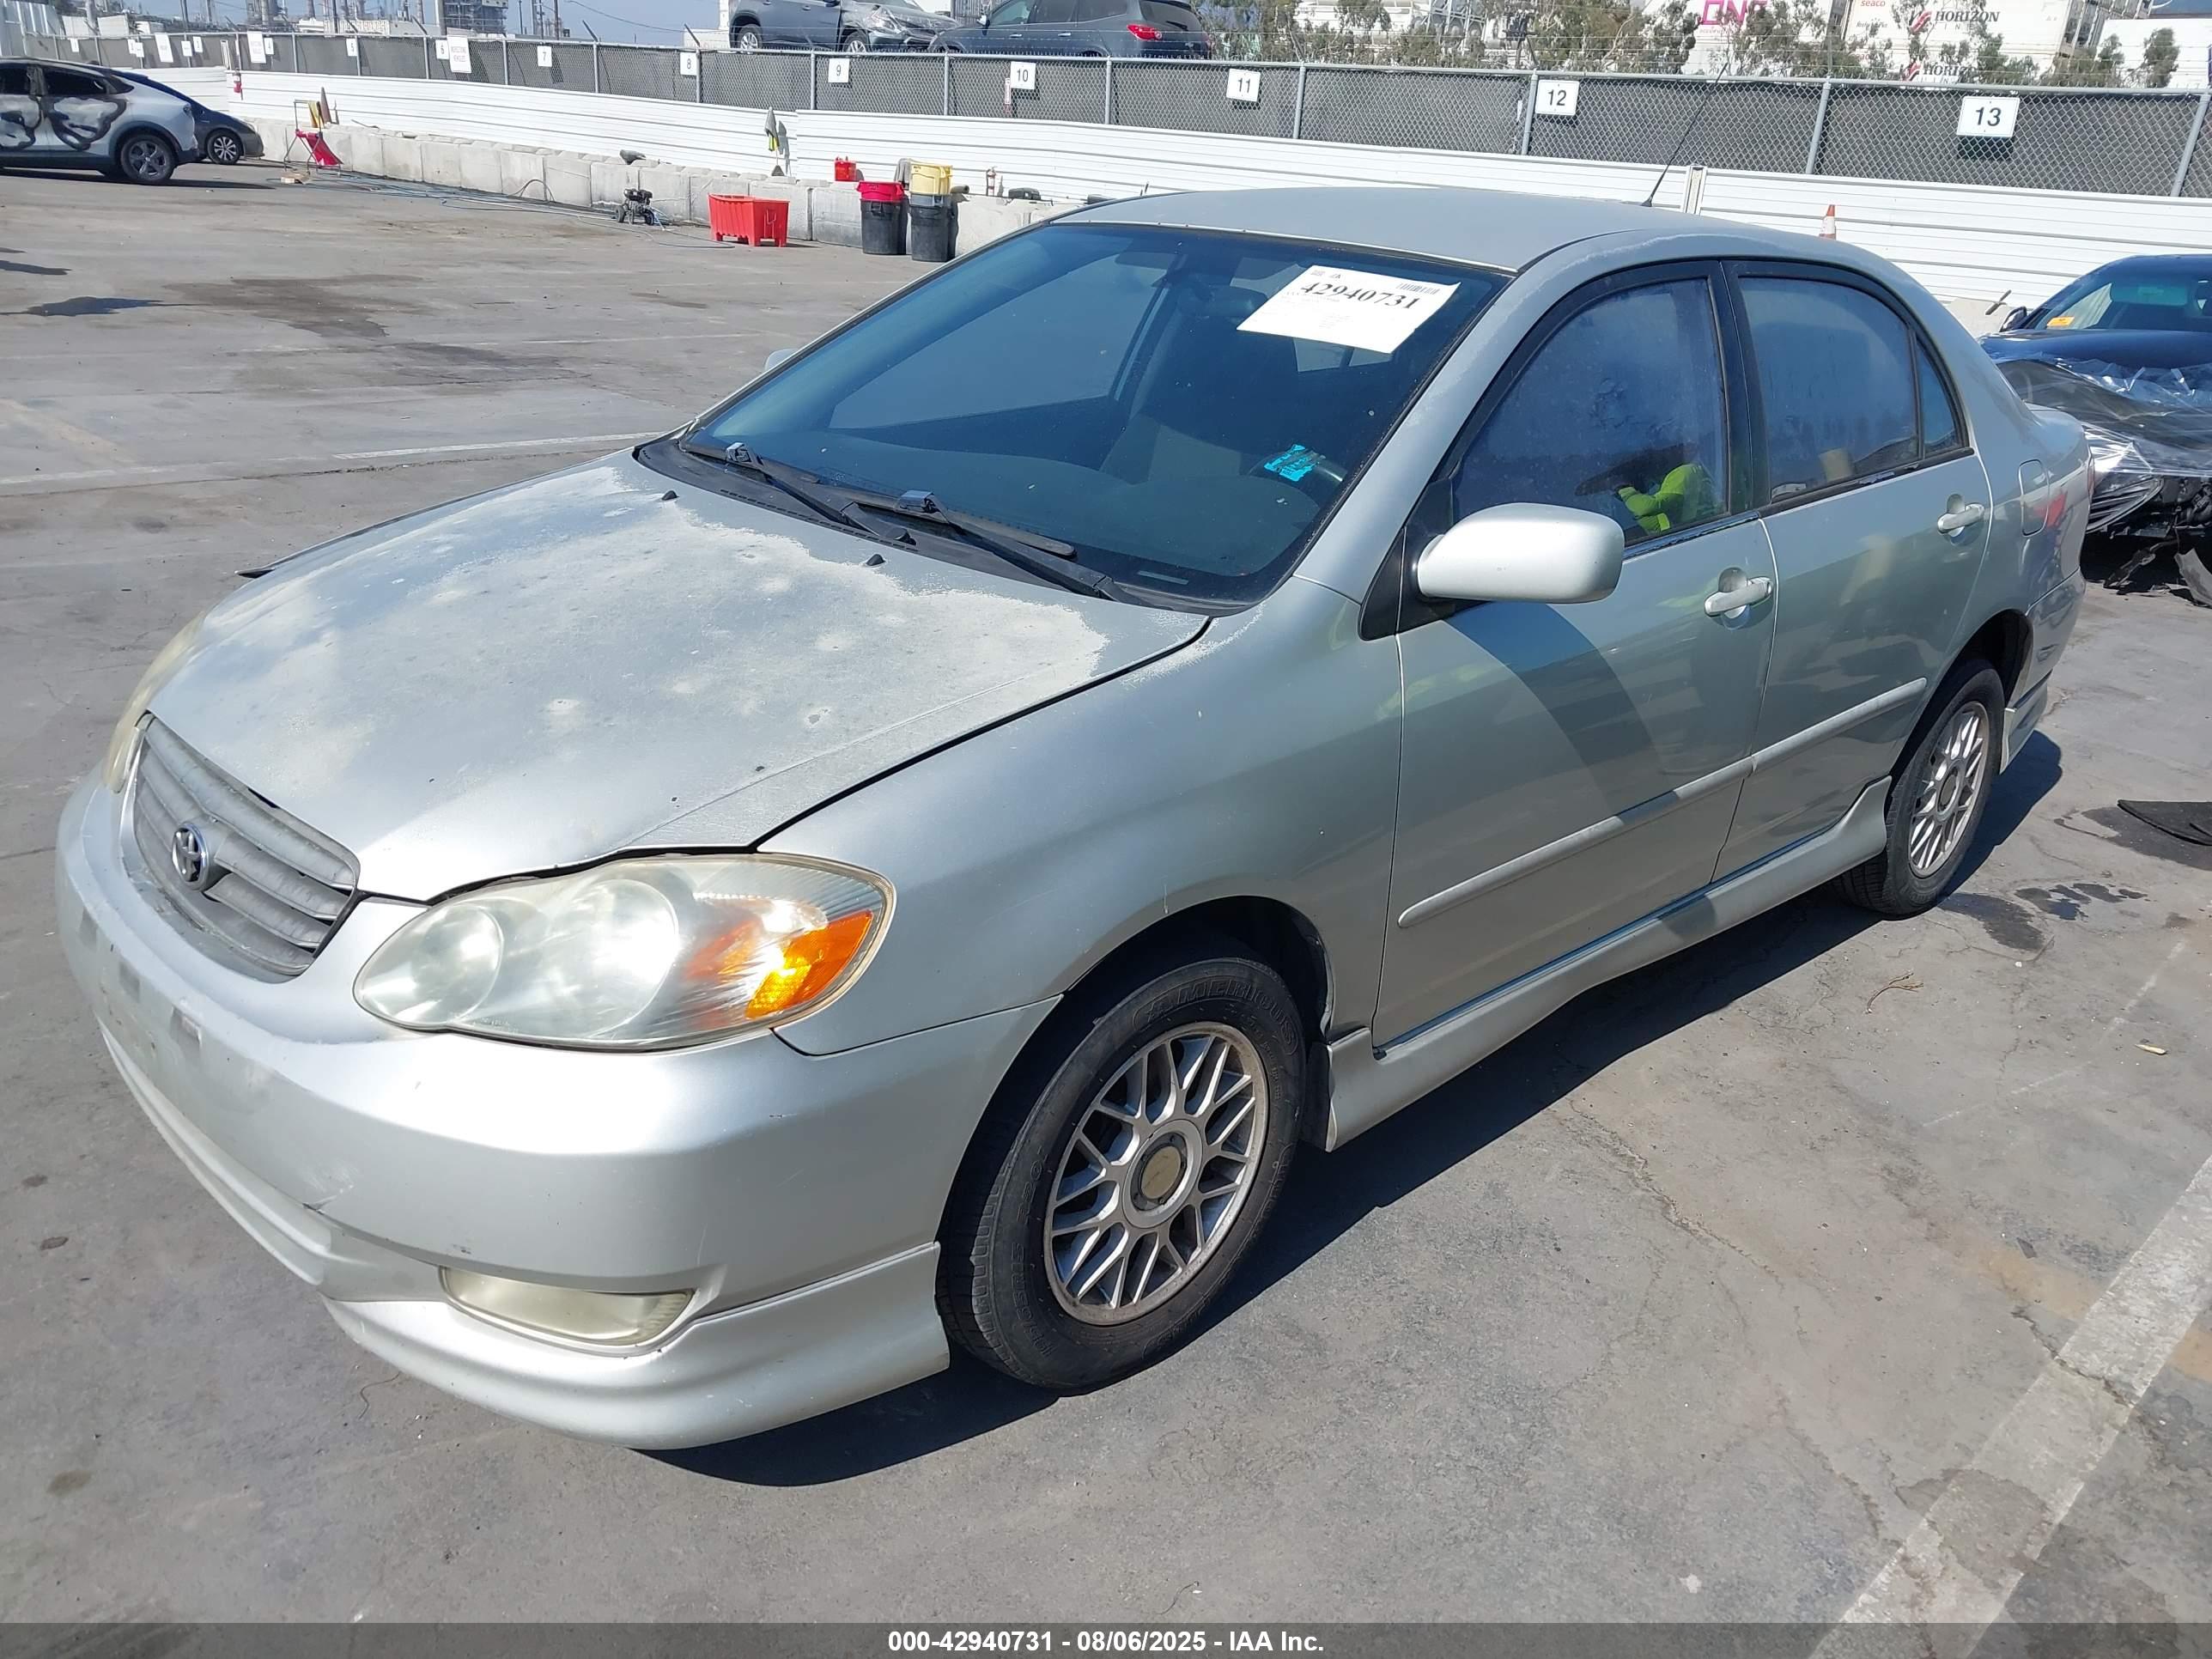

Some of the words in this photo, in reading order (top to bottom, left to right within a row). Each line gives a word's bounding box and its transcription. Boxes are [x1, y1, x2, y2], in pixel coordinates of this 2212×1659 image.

[1936, 11, 2000, 22] HORIZON
[542, 52, 547, 62] 7
[687, 58, 691, 70] 8
[836, 64, 842, 76] 9
[1017, 69, 1029, 82] 10
[1237, 79, 1251, 93] 11
[1548, 89, 1567, 106] 12
[1976, 107, 2001, 126] 13
[1300, 282, 1420, 309] 42940731
